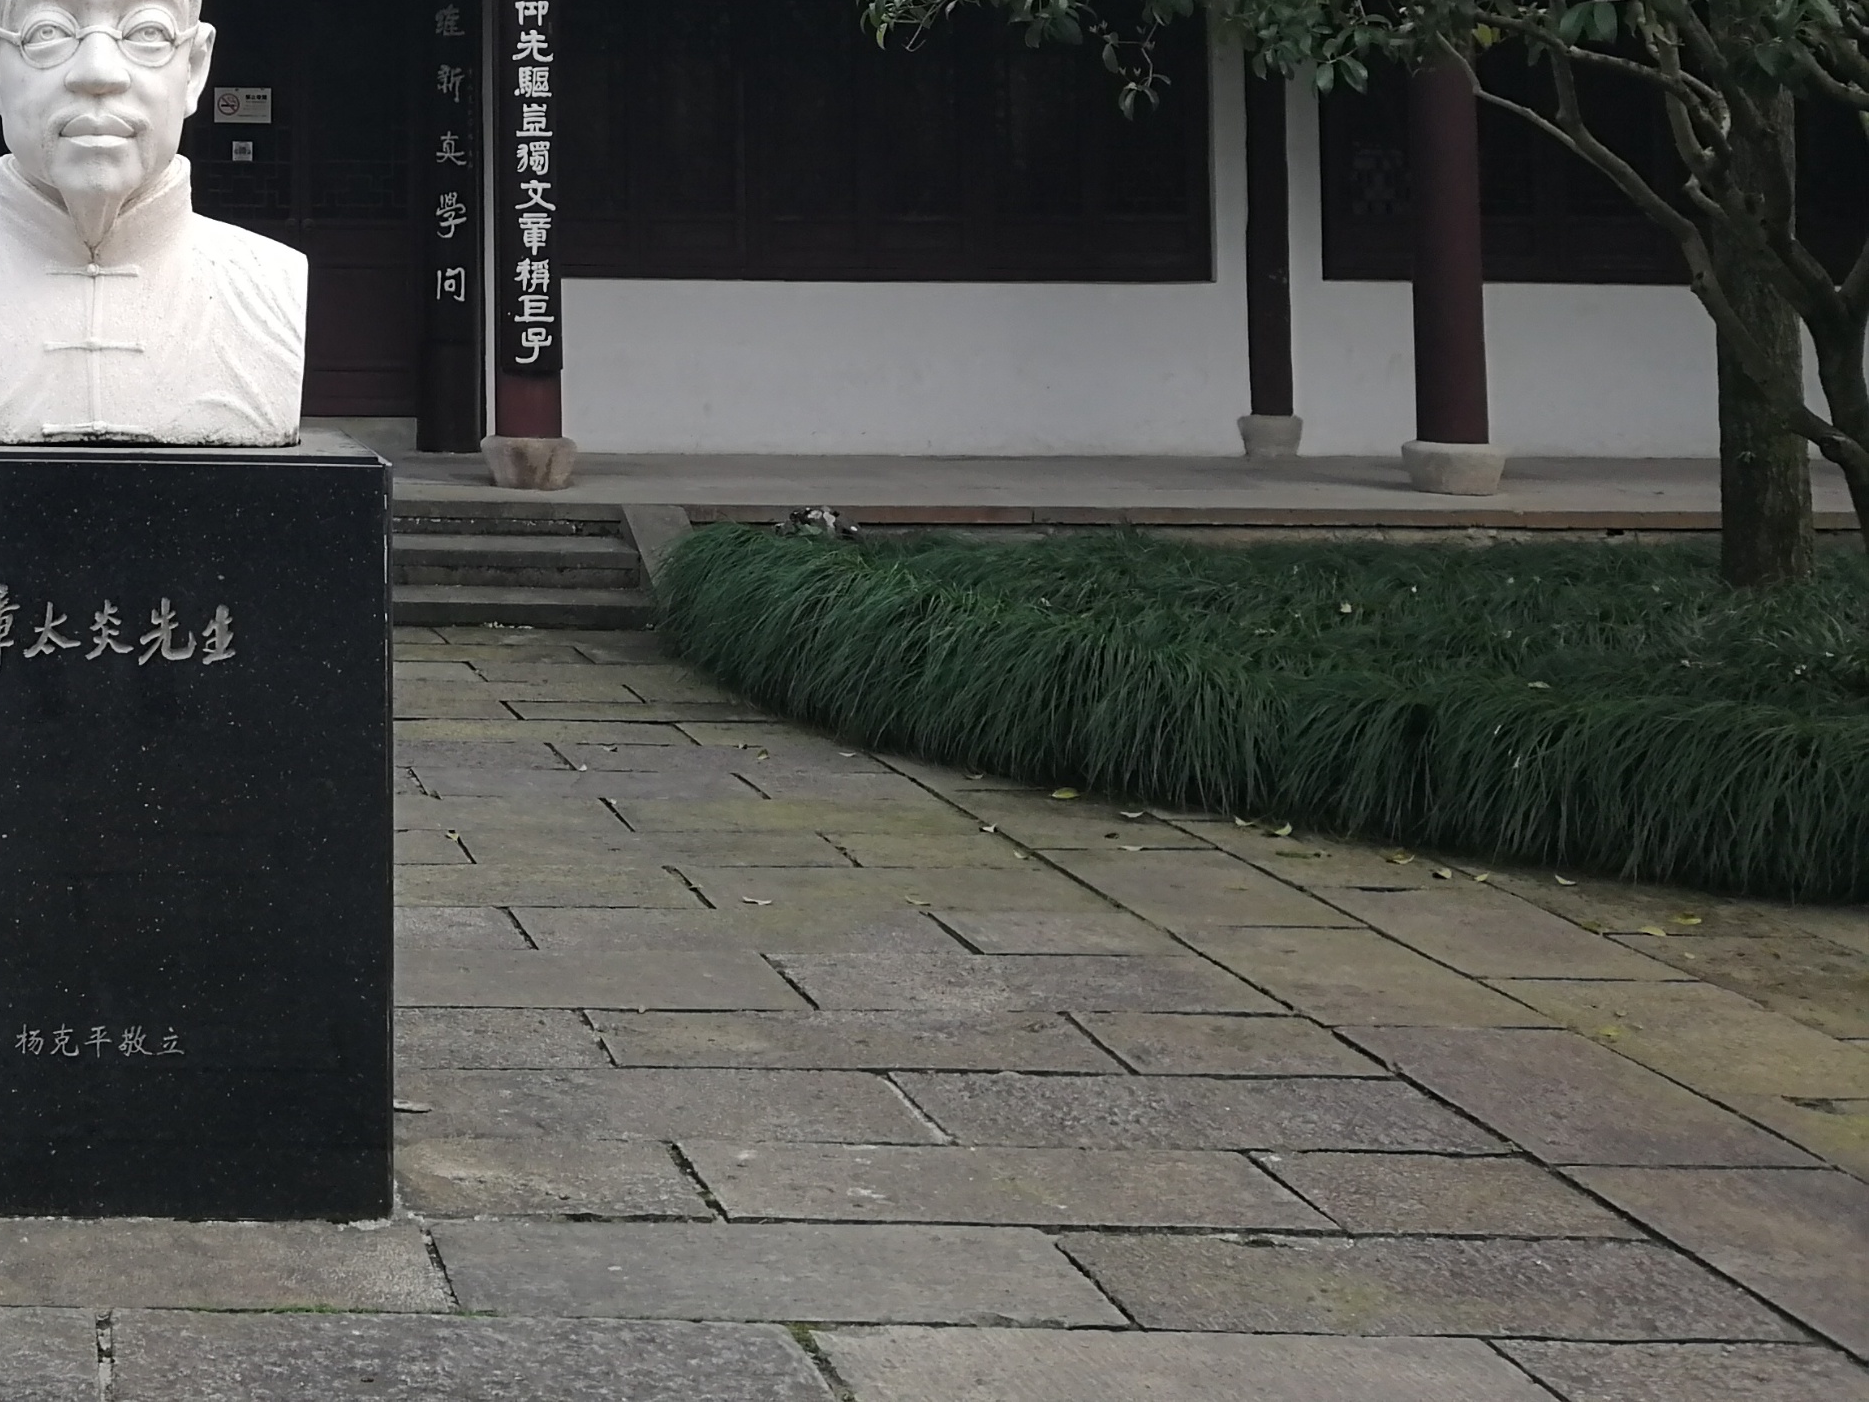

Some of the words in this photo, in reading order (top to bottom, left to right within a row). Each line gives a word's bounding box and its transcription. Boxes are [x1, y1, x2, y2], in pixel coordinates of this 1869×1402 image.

[15, 1023, 185, 1058] 杨克平敬立
